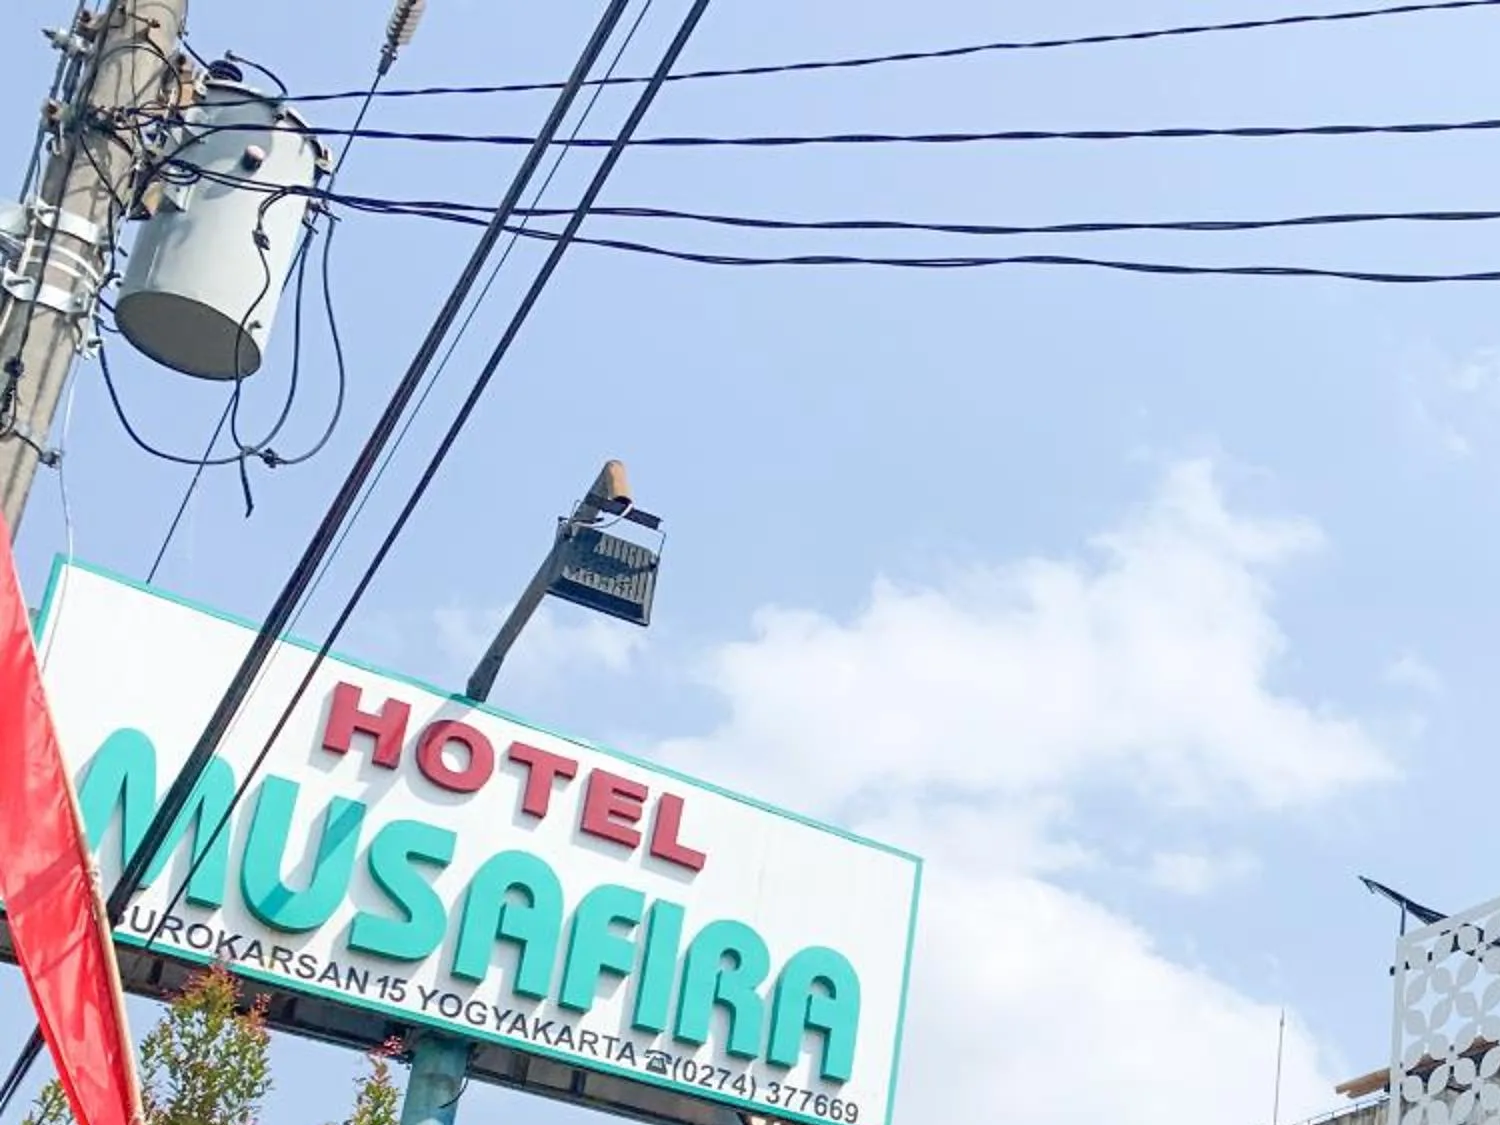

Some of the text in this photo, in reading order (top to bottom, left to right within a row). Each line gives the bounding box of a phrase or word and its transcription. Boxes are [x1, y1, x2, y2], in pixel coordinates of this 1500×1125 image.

[322, 681, 706, 872] HOTEL
[77, 727, 860, 1084] MUSAFIRA
[115, 904, 859, 1125] UROKARSAN 15 YOGYAKARTA (0274) 377669
